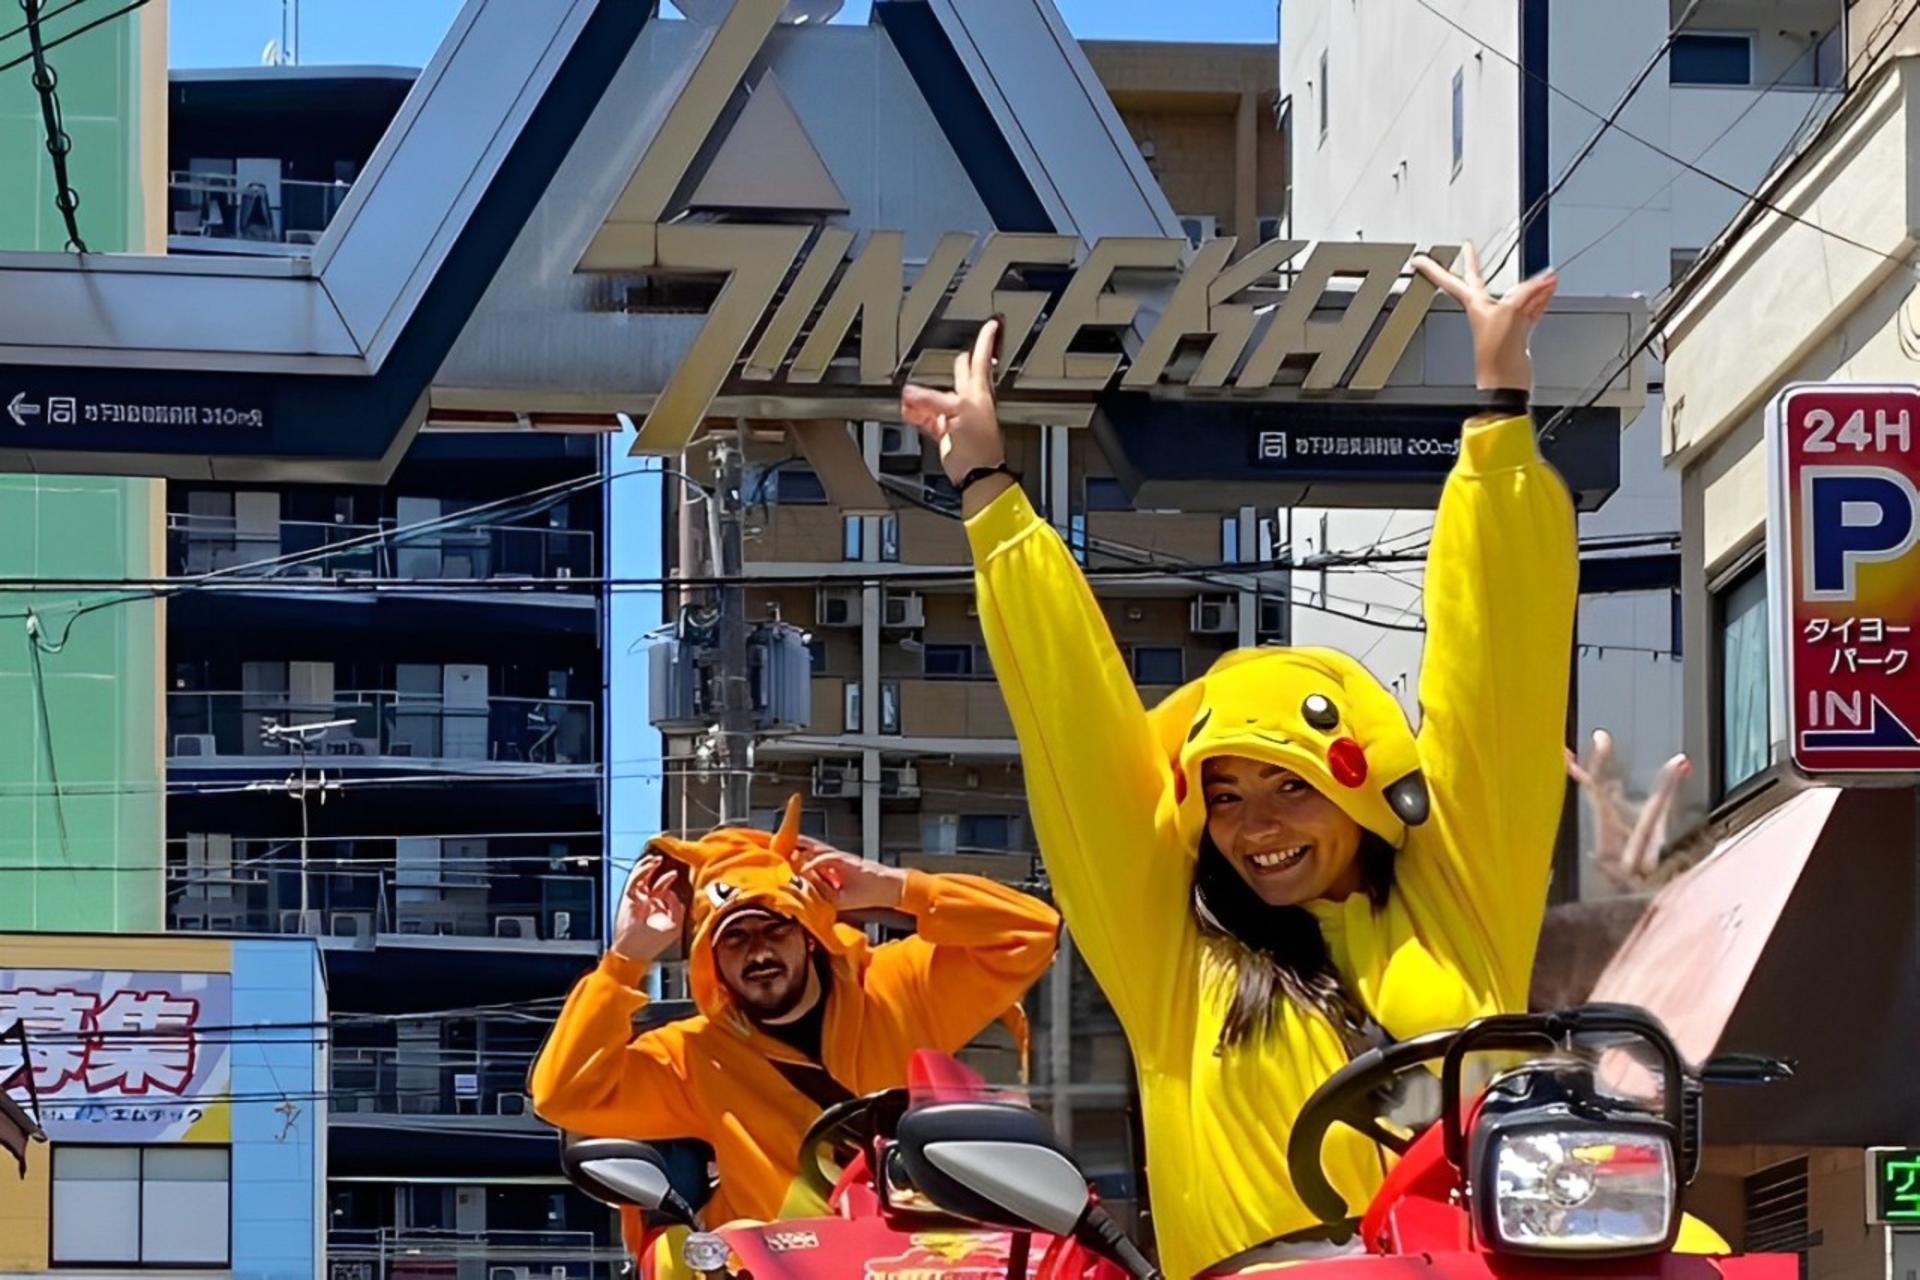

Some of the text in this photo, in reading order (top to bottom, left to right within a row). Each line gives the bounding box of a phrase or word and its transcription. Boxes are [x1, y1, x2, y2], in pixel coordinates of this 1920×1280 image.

[1803, 409, 1910, 452] 24H
[1801, 465, 1919, 602] P
[1804, 617, 1910, 643] タイヨー
[1828, 649, 1908, 675] パーク
[1808, 690, 1862, 727] IN
